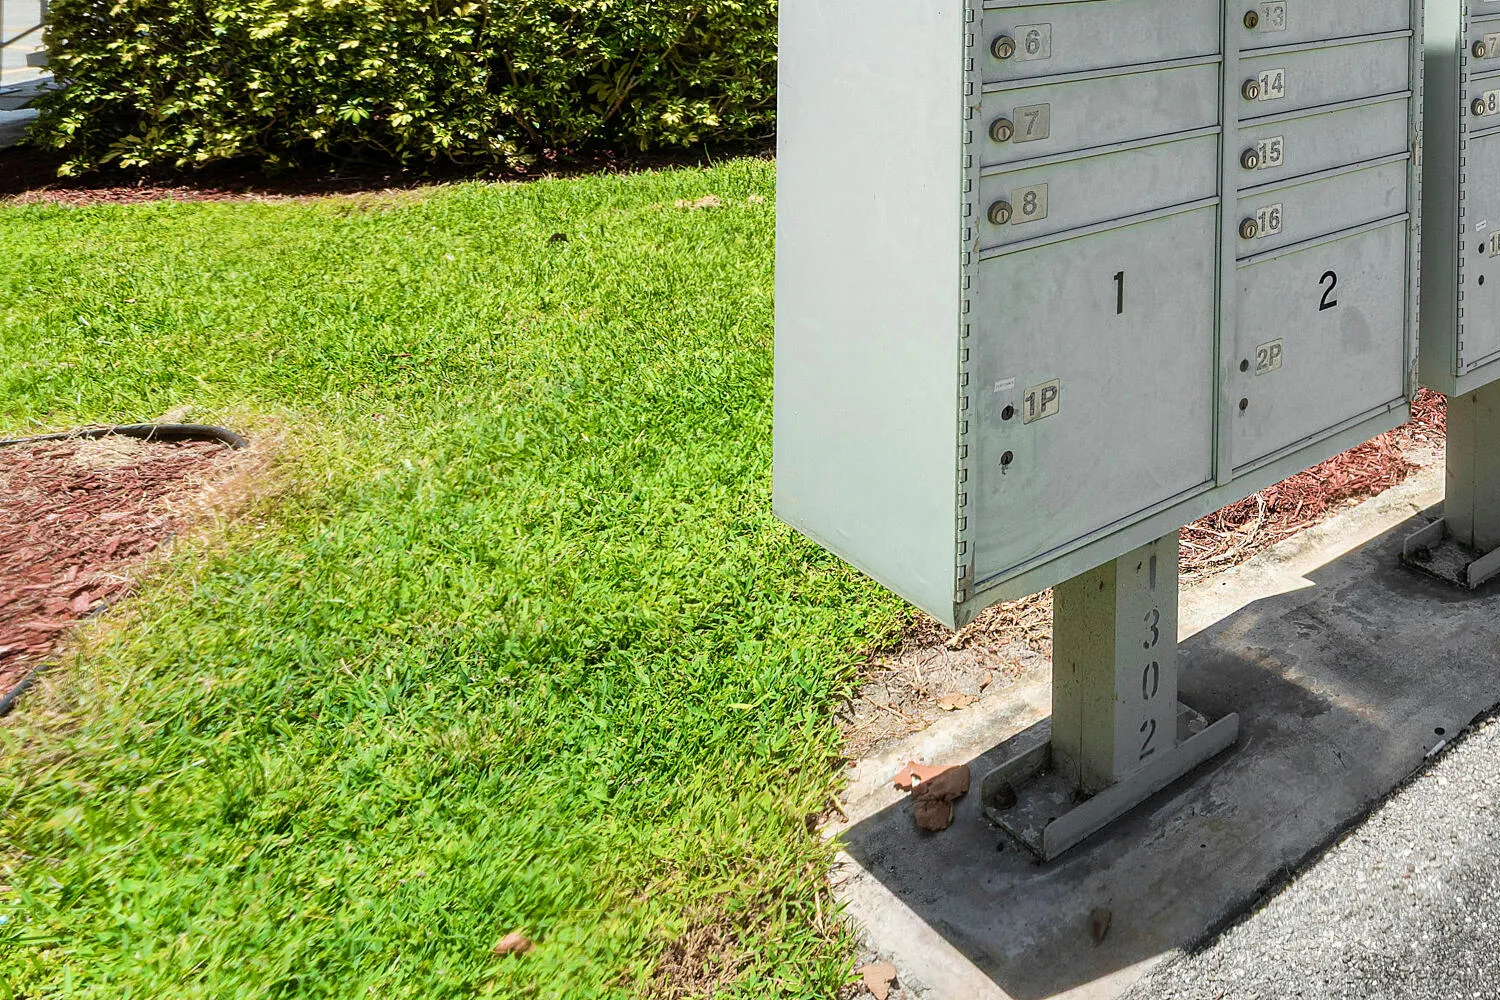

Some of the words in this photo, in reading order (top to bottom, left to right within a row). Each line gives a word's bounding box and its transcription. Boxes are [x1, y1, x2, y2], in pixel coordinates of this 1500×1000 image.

[1265, 5, 1284, 27] 13
[1025, 29, 1040, 55] 6
[1488, 37, 1497, 55] 7
[1260, 72, 1283, 96] 14
[1488, 94, 1497, 112] 8
[1024, 109, 1040, 136] 7
[1259, 140, 1282, 166] 15
[1022, 189, 1038, 217] 8
[1258, 207, 1281, 232] 16
[1113, 270, 1125, 315] 1
[1318, 270, 1339, 312] 2
[1256, 343, 1283, 372] 2P
[1024, 385, 1058, 417] 1P
